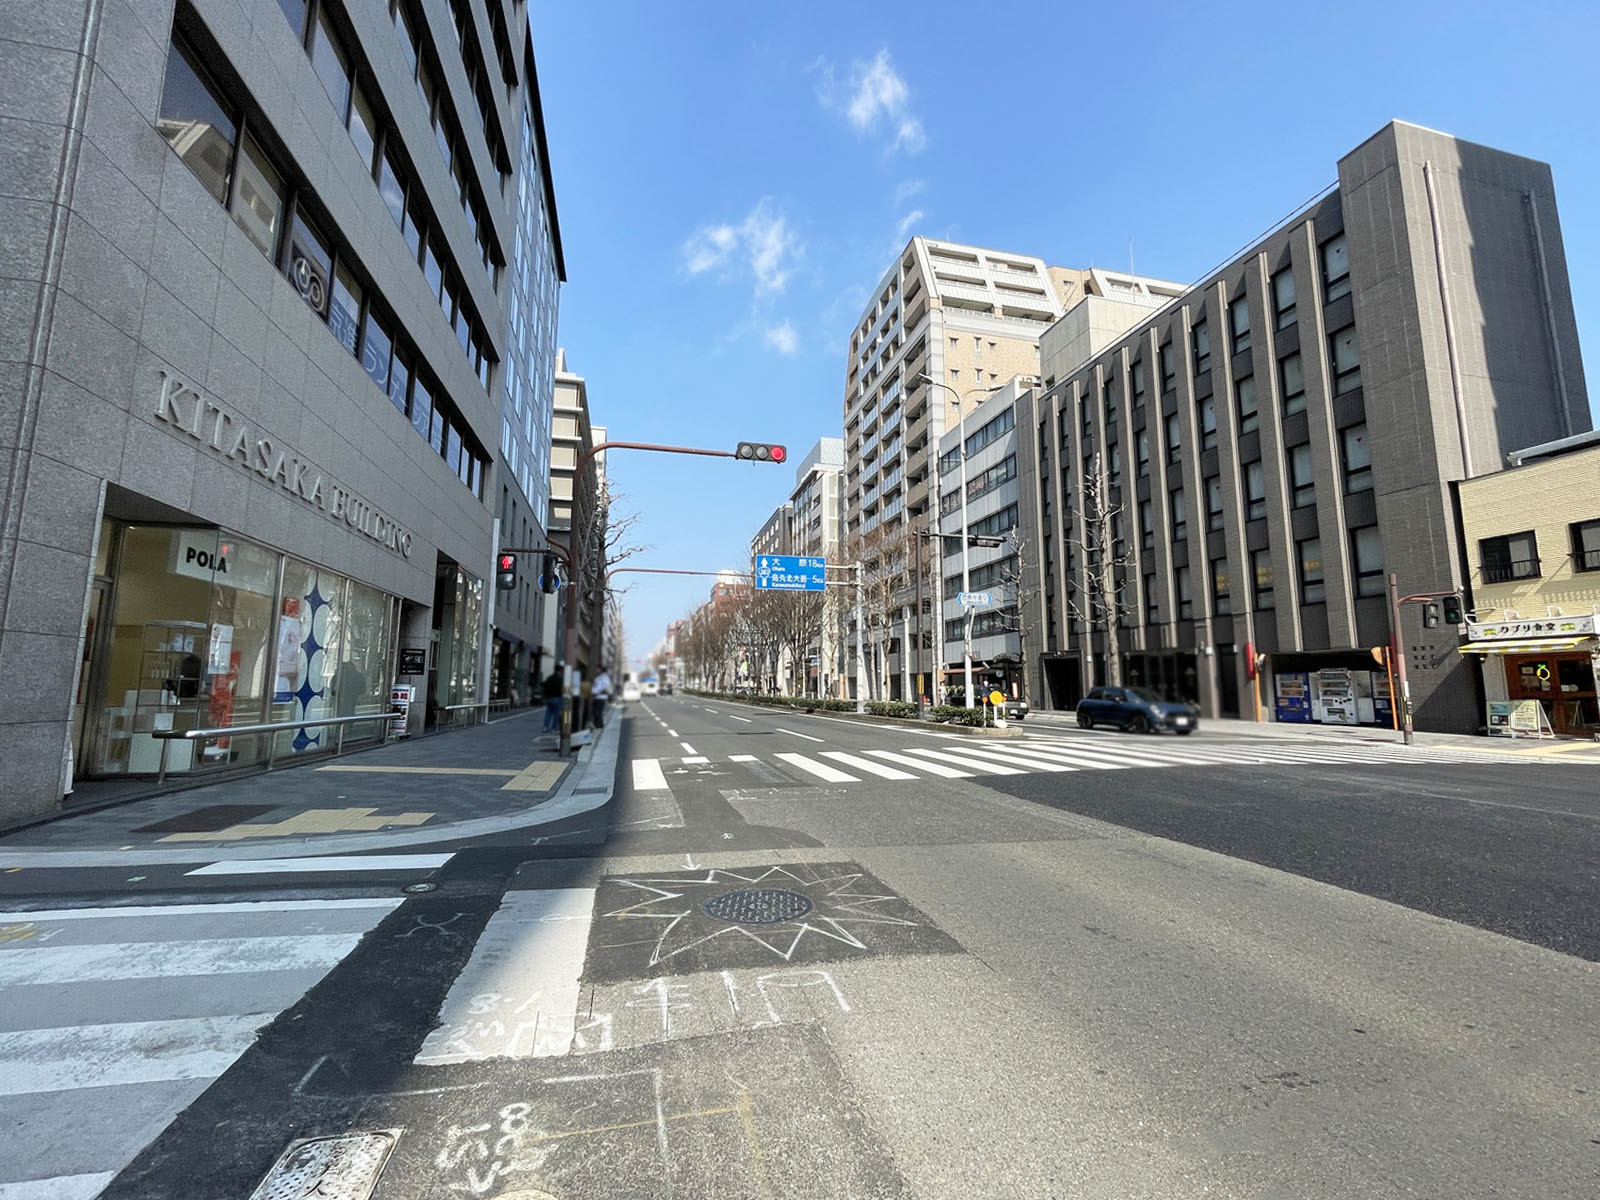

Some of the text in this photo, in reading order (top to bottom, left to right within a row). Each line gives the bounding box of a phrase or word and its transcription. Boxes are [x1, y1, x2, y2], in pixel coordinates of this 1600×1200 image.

[154, 370, 413, 558] KITASAKA BUILDING
[186, 546, 228, 575] POLA
